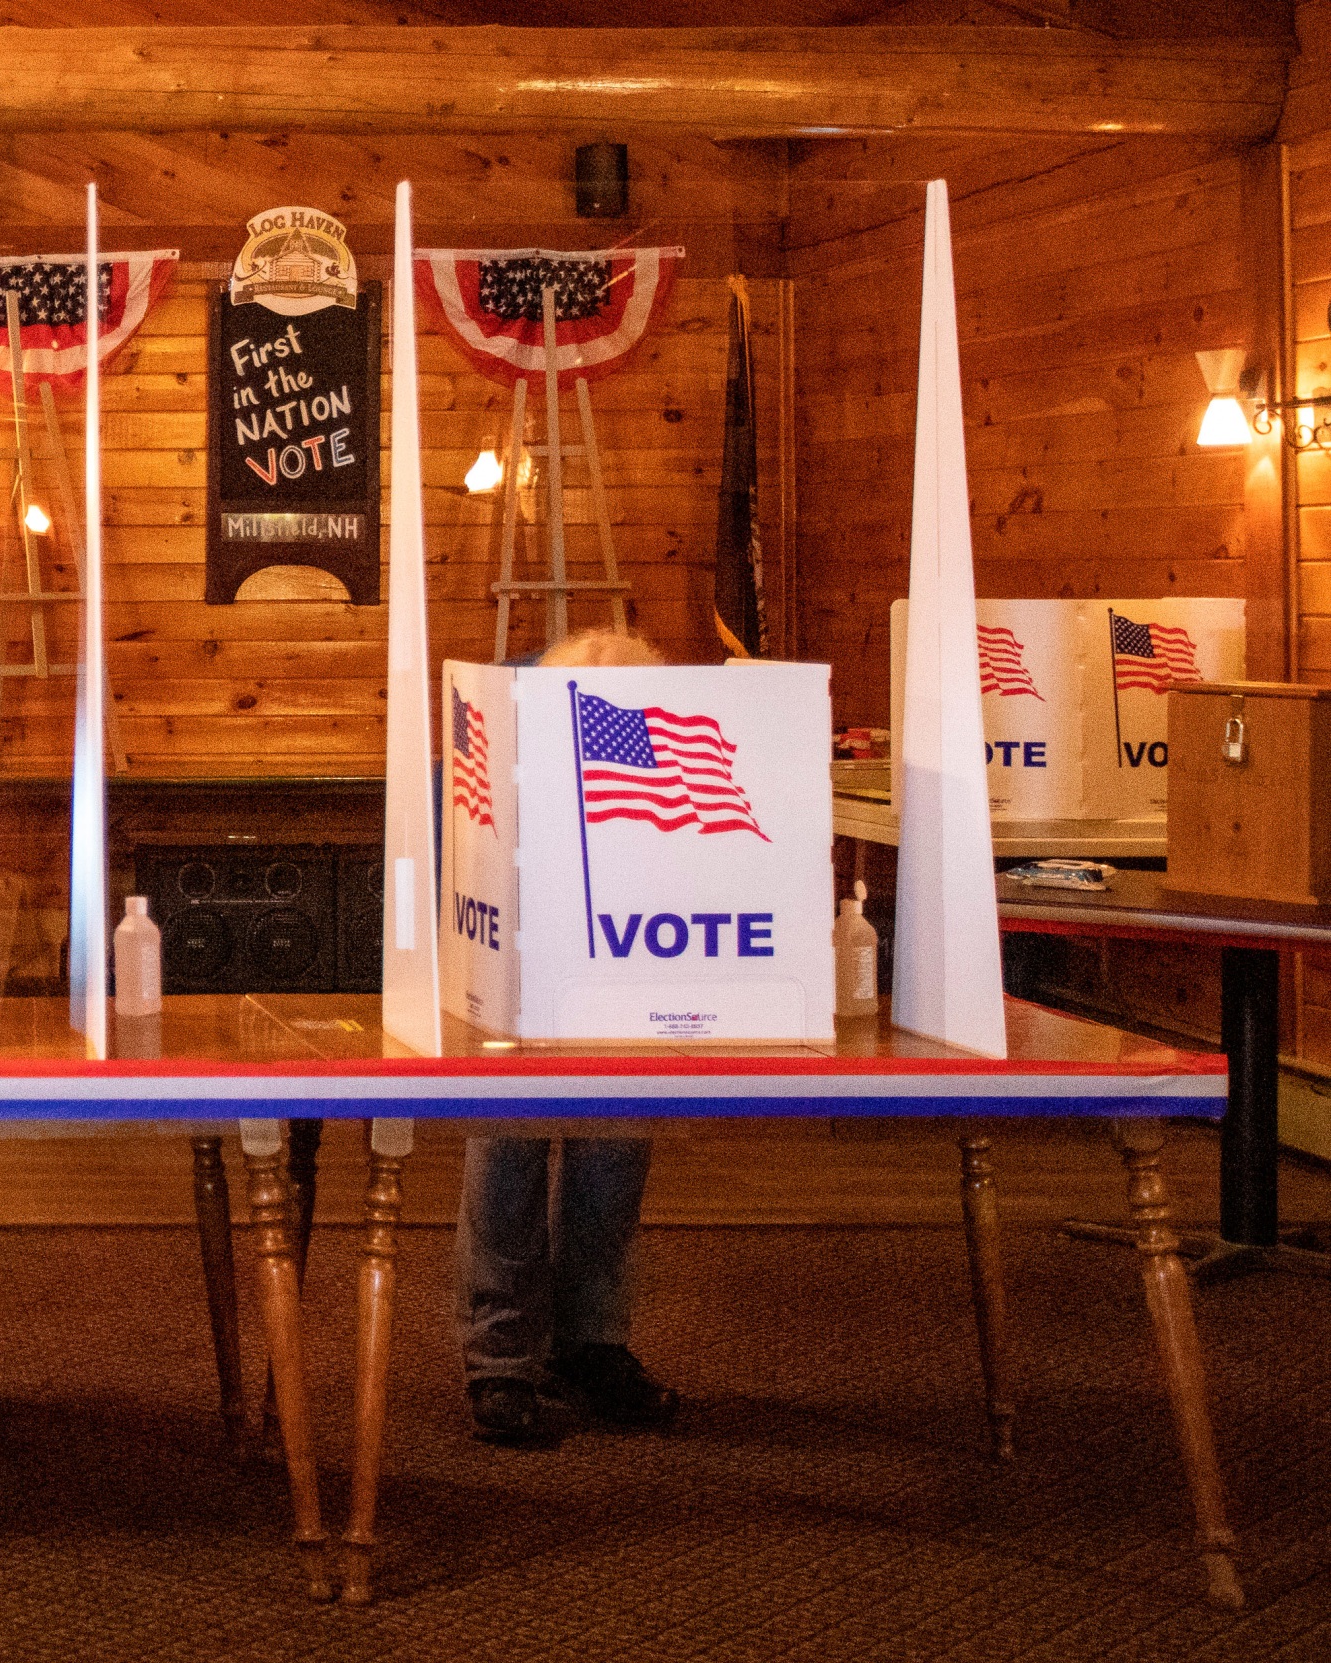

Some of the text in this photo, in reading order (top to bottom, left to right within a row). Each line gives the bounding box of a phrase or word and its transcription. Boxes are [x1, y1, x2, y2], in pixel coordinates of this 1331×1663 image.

[247, 211, 346, 242] LOG HAVEN
[230, 324, 303, 376] First
[233, 366, 313, 409] in the
[235, 385, 352, 445] NATION
[245, 427, 355, 486] VOTE
[328, 516, 358, 539] NH
[985, 741, 1047, 768] TE
[1123, 741, 1169, 768] VO
[454, 891, 500, 952] VOTE
[597, 912, 775, 958] VOTE
[649, 1012, 718, 1022] ElectionSource
